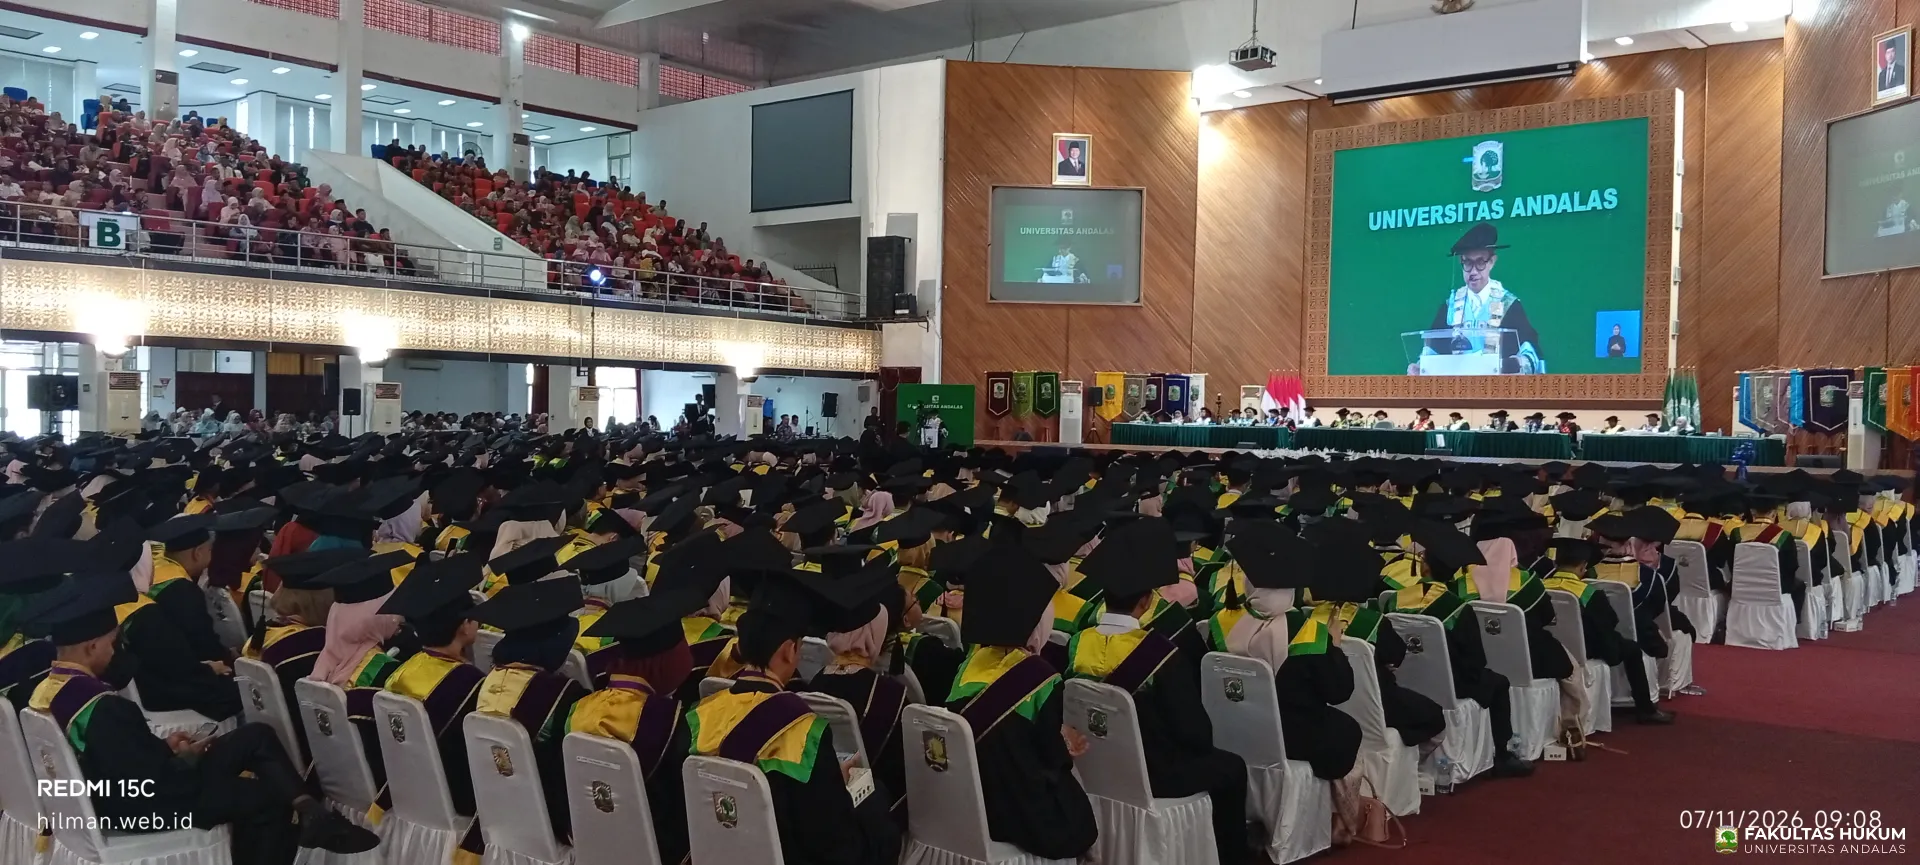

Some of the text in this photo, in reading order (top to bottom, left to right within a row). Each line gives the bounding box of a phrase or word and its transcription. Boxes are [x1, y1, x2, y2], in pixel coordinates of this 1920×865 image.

[1368, 187, 1618, 231] UNIVERSITAS ANDALAS
[96, 221, 121, 247] B
[1020, 226, 1115, 235] UNIVERSITAS ANDALAS
